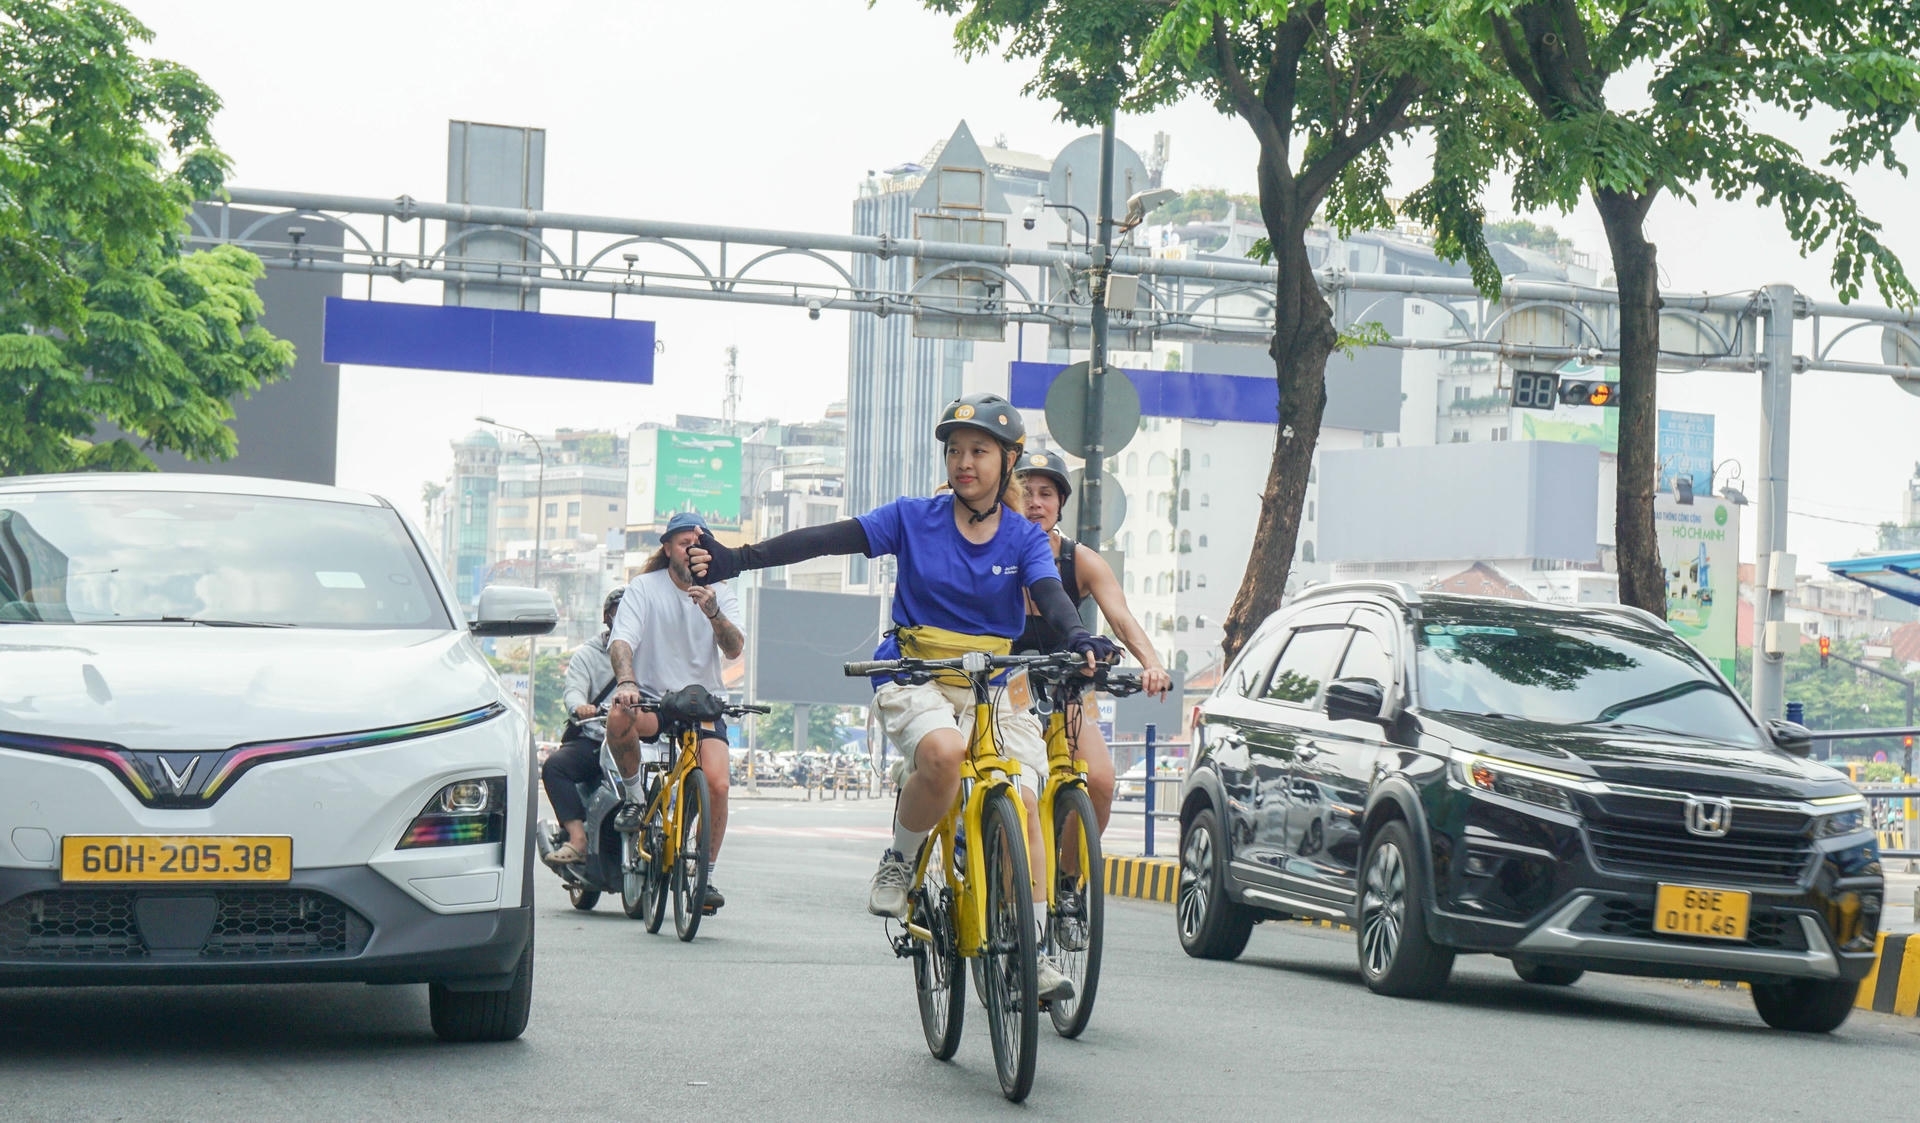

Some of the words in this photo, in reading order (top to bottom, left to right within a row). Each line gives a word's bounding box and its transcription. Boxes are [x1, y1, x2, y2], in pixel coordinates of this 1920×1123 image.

[1703, 528, 1725, 541] MINH
[82, 844, 272, 873] 60H-205.38
[1684, 889, 1722, 912] 68E
[1665, 910, 1737, 935] 011.46
